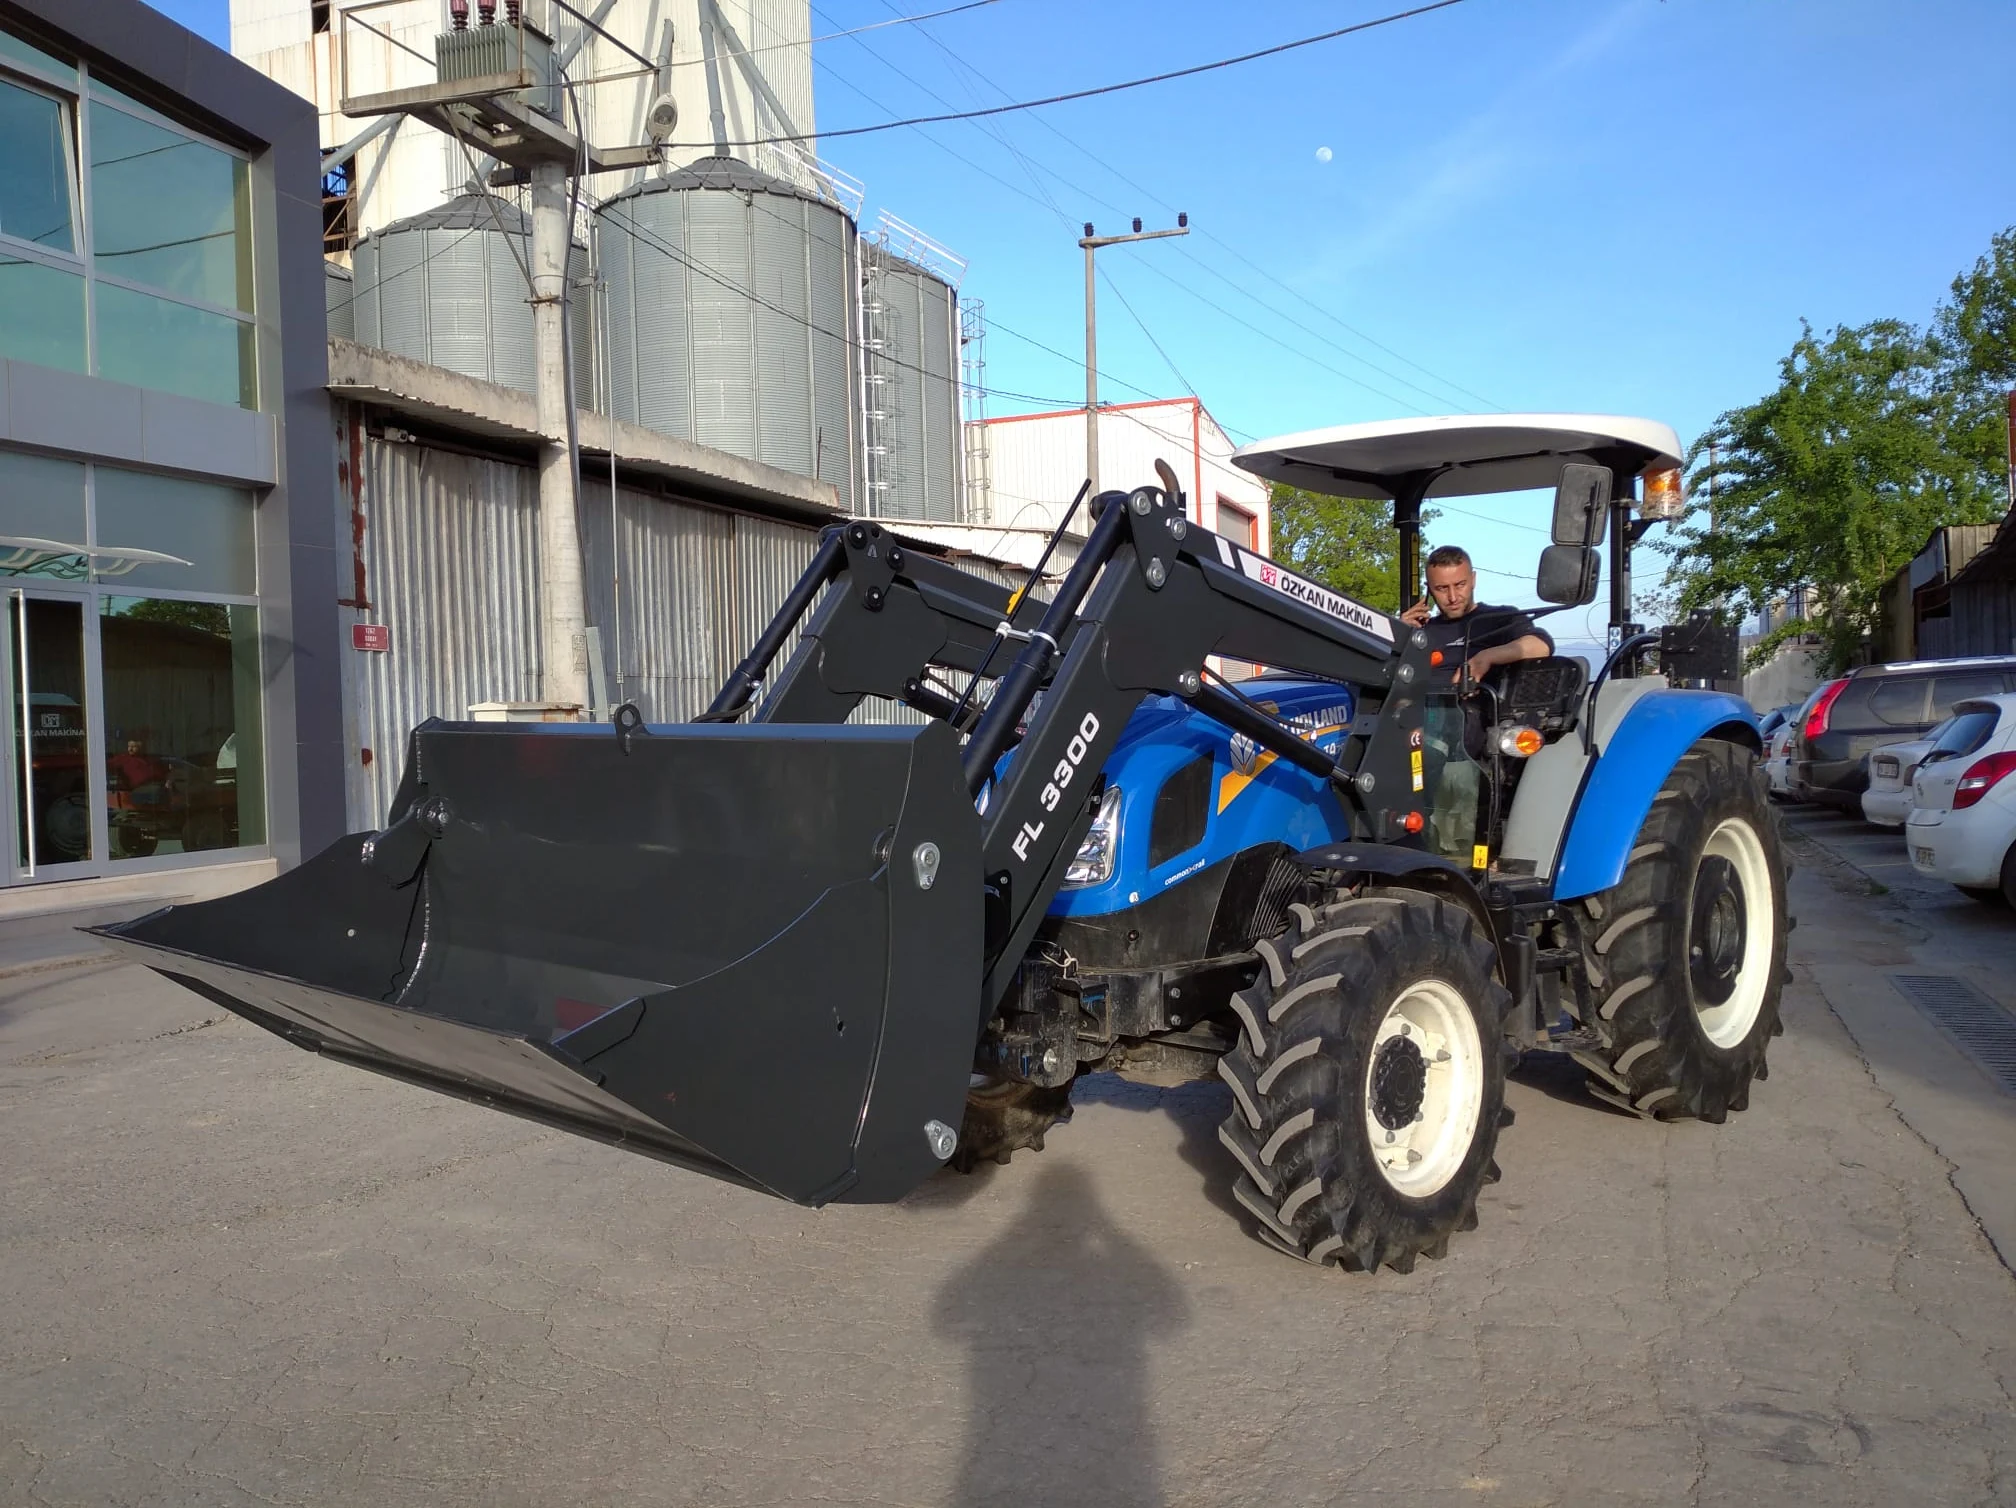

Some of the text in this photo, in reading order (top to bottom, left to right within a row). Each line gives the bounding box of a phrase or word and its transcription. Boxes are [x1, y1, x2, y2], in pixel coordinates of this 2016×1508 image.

[1281, 573, 1325, 608] ÖZKAN
[1327, 597, 1374, 631] MAKİNA
[1011, 711, 1100, 862] FL 3300
